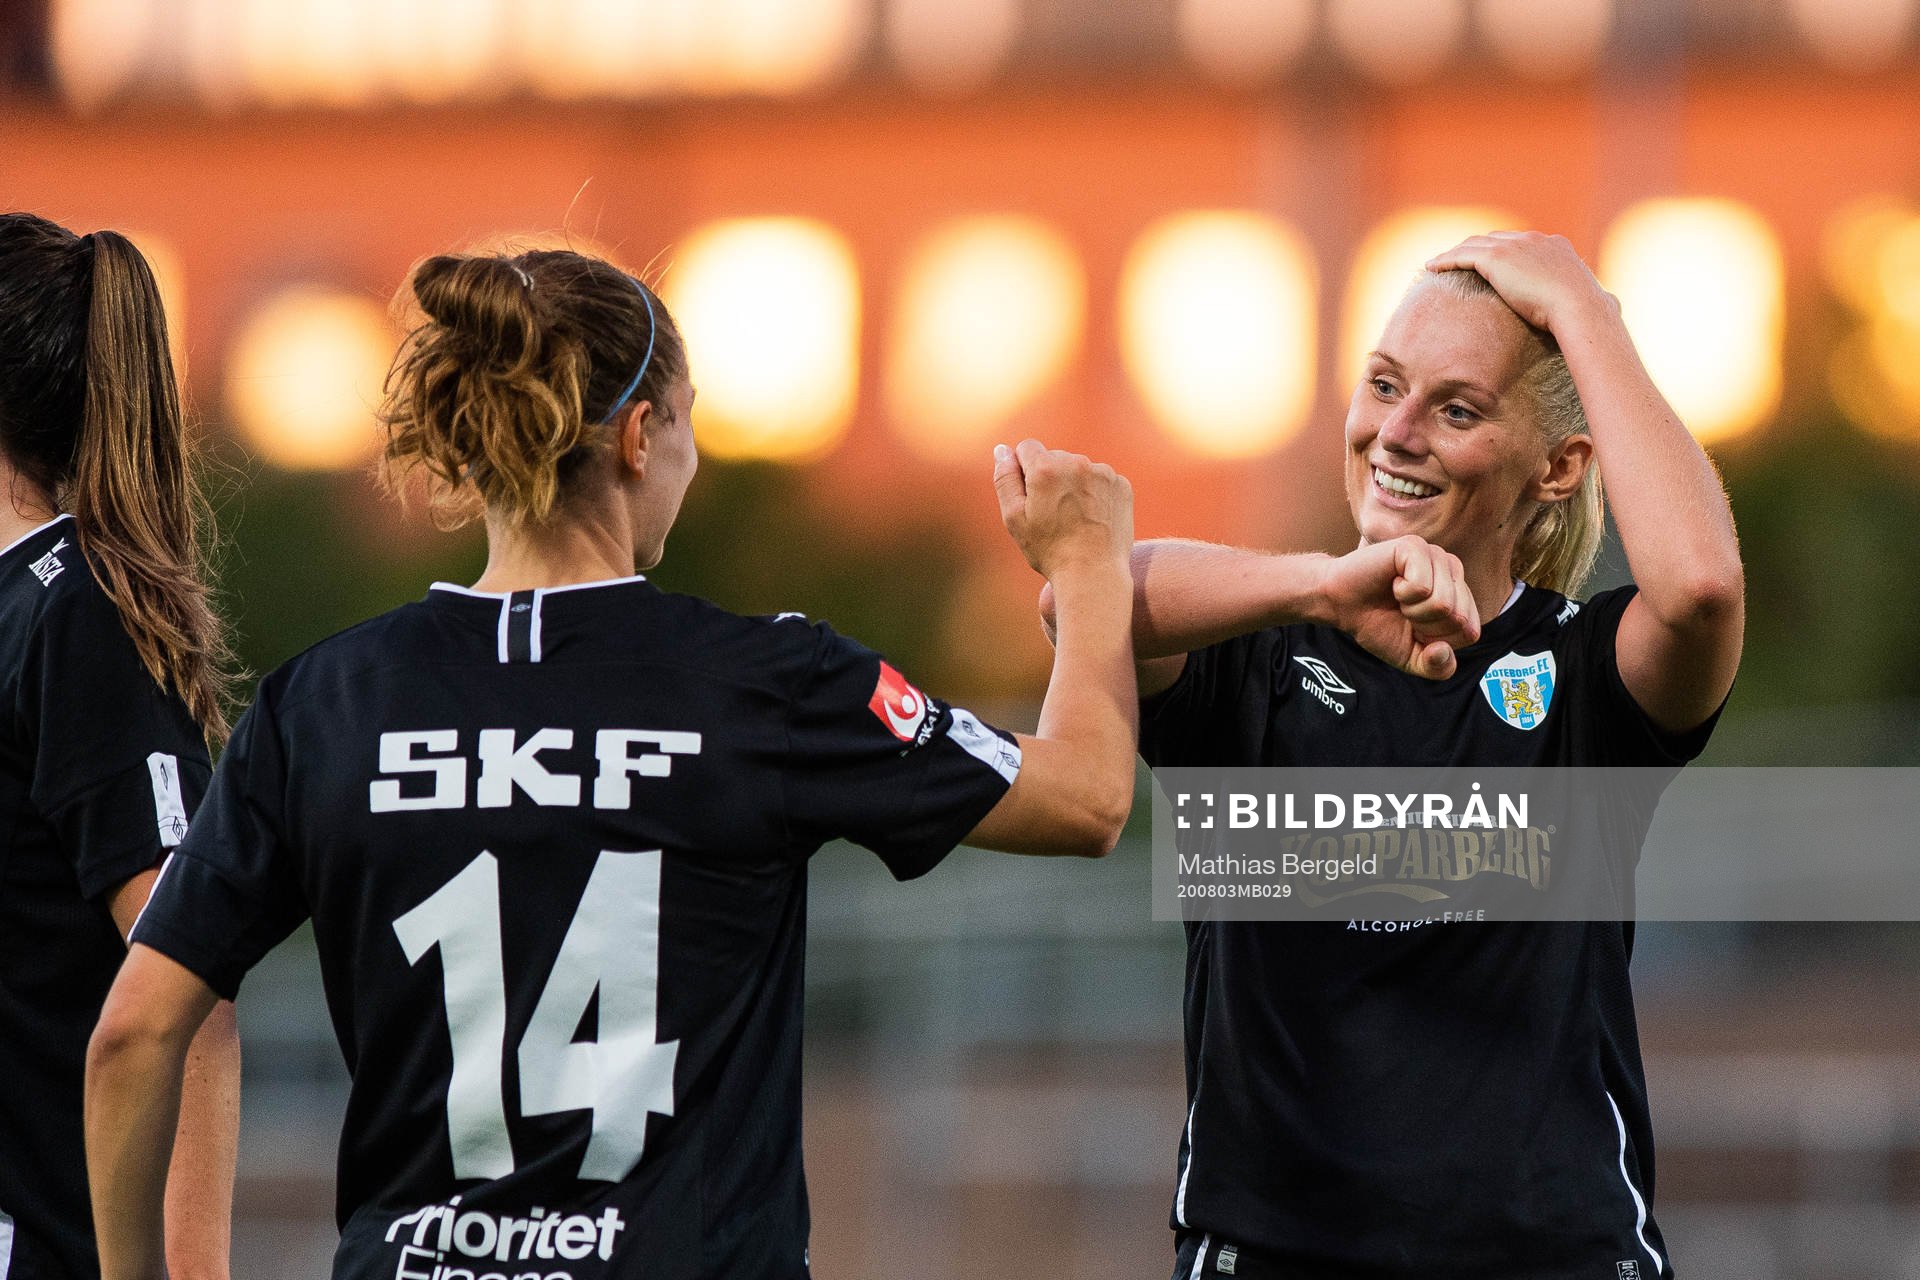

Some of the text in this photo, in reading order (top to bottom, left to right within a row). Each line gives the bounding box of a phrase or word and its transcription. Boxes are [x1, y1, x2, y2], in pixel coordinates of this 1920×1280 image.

[1536, 657, 1550, 672] FC
[1301, 676, 1345, 715] umbro
[370, 728, 702, 813] SKF
[1278, 824, 1552, 896] KOPPARBERG
[1346, 909, 1486, 933] ALCOHOL-FREE
[392, 849, 680, 1183] 14
